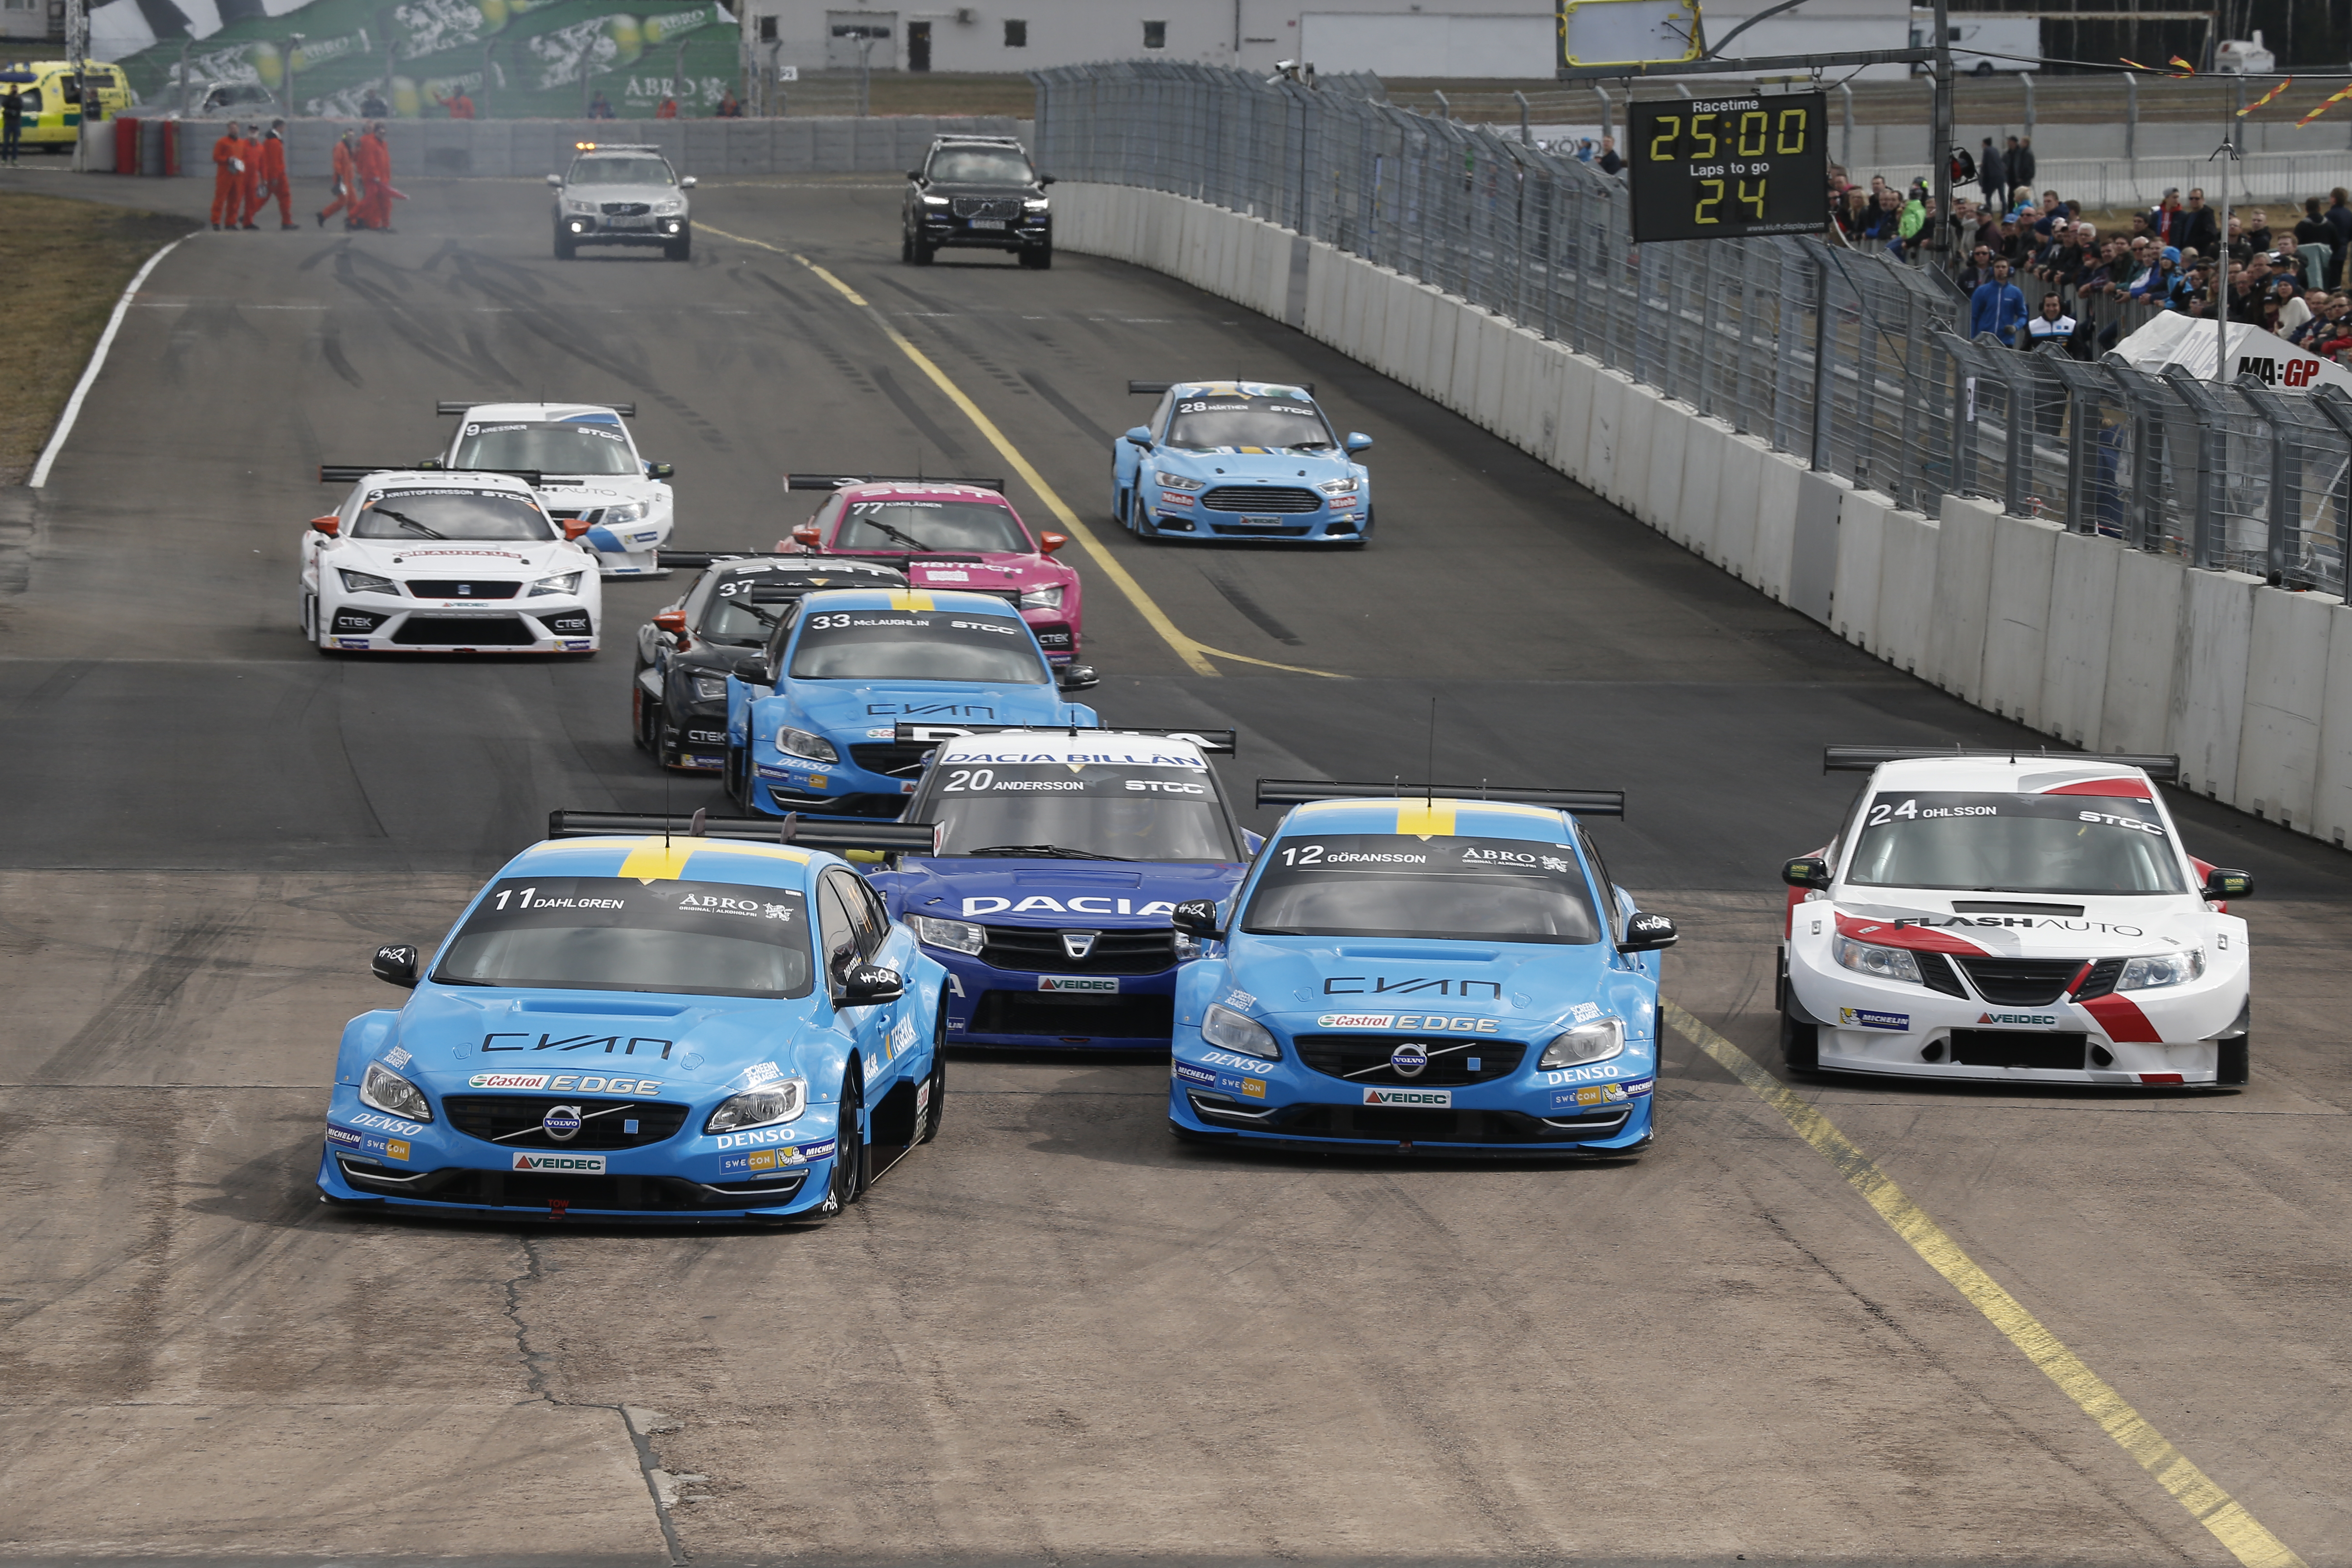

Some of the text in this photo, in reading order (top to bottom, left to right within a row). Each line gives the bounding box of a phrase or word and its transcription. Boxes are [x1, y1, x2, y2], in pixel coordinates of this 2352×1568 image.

[1692, 100, 1759, 113] Racetime
[1650, 109, 1807, 161] 25:00
[1690, 162, 1769, 177] Laps to go
[1695, 179, 1766, 224] 24
[1180, 402, 1206, 413] 28
[1270, 405, 1314, 416] STCC
[466, 424, 624, 442] 9 KRESSNER STCC
[370, 489, 534, 504] 3 KRISTOFFERSSON STCC
[852, 502, 885, 515] 77
[414, 550, 522, 559] BAUHAUS
[735, 565, 890, 576] SEAT
[719, 579, 755, 597] 37
[338, 616, 372, 627] CTEK
[555, 618, 586, 628] CTEK
[812, 614, 1018, 635] 33 McLAUGHLIN STCC
[1039, 633, 1069, 643] CTEK
[688, 730, 726, 742] CTEK
[776, 758, 833, 772] DENSO
[943, 753, 1200, 766] DACIA BILLÅN
[943, 769, 1205, 794] 20 ANDERSSON STCC
[1868, 799, 2166, 836] 24 OHLSSON STCC
[1281, 845, 1426, 867] 12 GÖRANSSON
[1462, 847, 1536, 863] ÅBRO
[1497, 861, 1537, 869] ALKOHOLFRI
[495, 887, 625, 911] 11 DAHLGREN
[679, 893, 759, 911] ÅBRO
[962, 896, 1177, 917] DACIA
[715, 909, 758, 917] ALKOHOLFRI
[1178, 902, 1206, 918] HiQ
[1636, 915, 1672, 931] HiQ
[378, 946, 406, 963] HiQ
[859, 968, 898, 985] HiQ
[1051, 979, 1116, 990] VEIDEC
[1336, 1015, 1502, 1033] Castrol EDGE
[1862, 1014, 1909, 1024] MICHELIN
[1992, 1014, 2056, 1024] VEIDEC
[891, 1012, 916, 1054] TEGERA
[1200, 1051, 1274, 1074] DENSO
[1177, 1066, 1216, 1082] MICHELIN
[1547, 1066, 1619, 1085] DENSO
[487, 1074, 666, 1096] Castrol EDGE
[1377, 1092, 1446, 1104] VEIDEC
[349, 1113, 423, 1136] DENSO
[328, 1128, 361, 1143] MICHELIN
[716, 1128, 795, 1149] DENSO
[528, 1157, 601, 1170] VEIDEC
[548, 1199, 569, 1207] TOW
